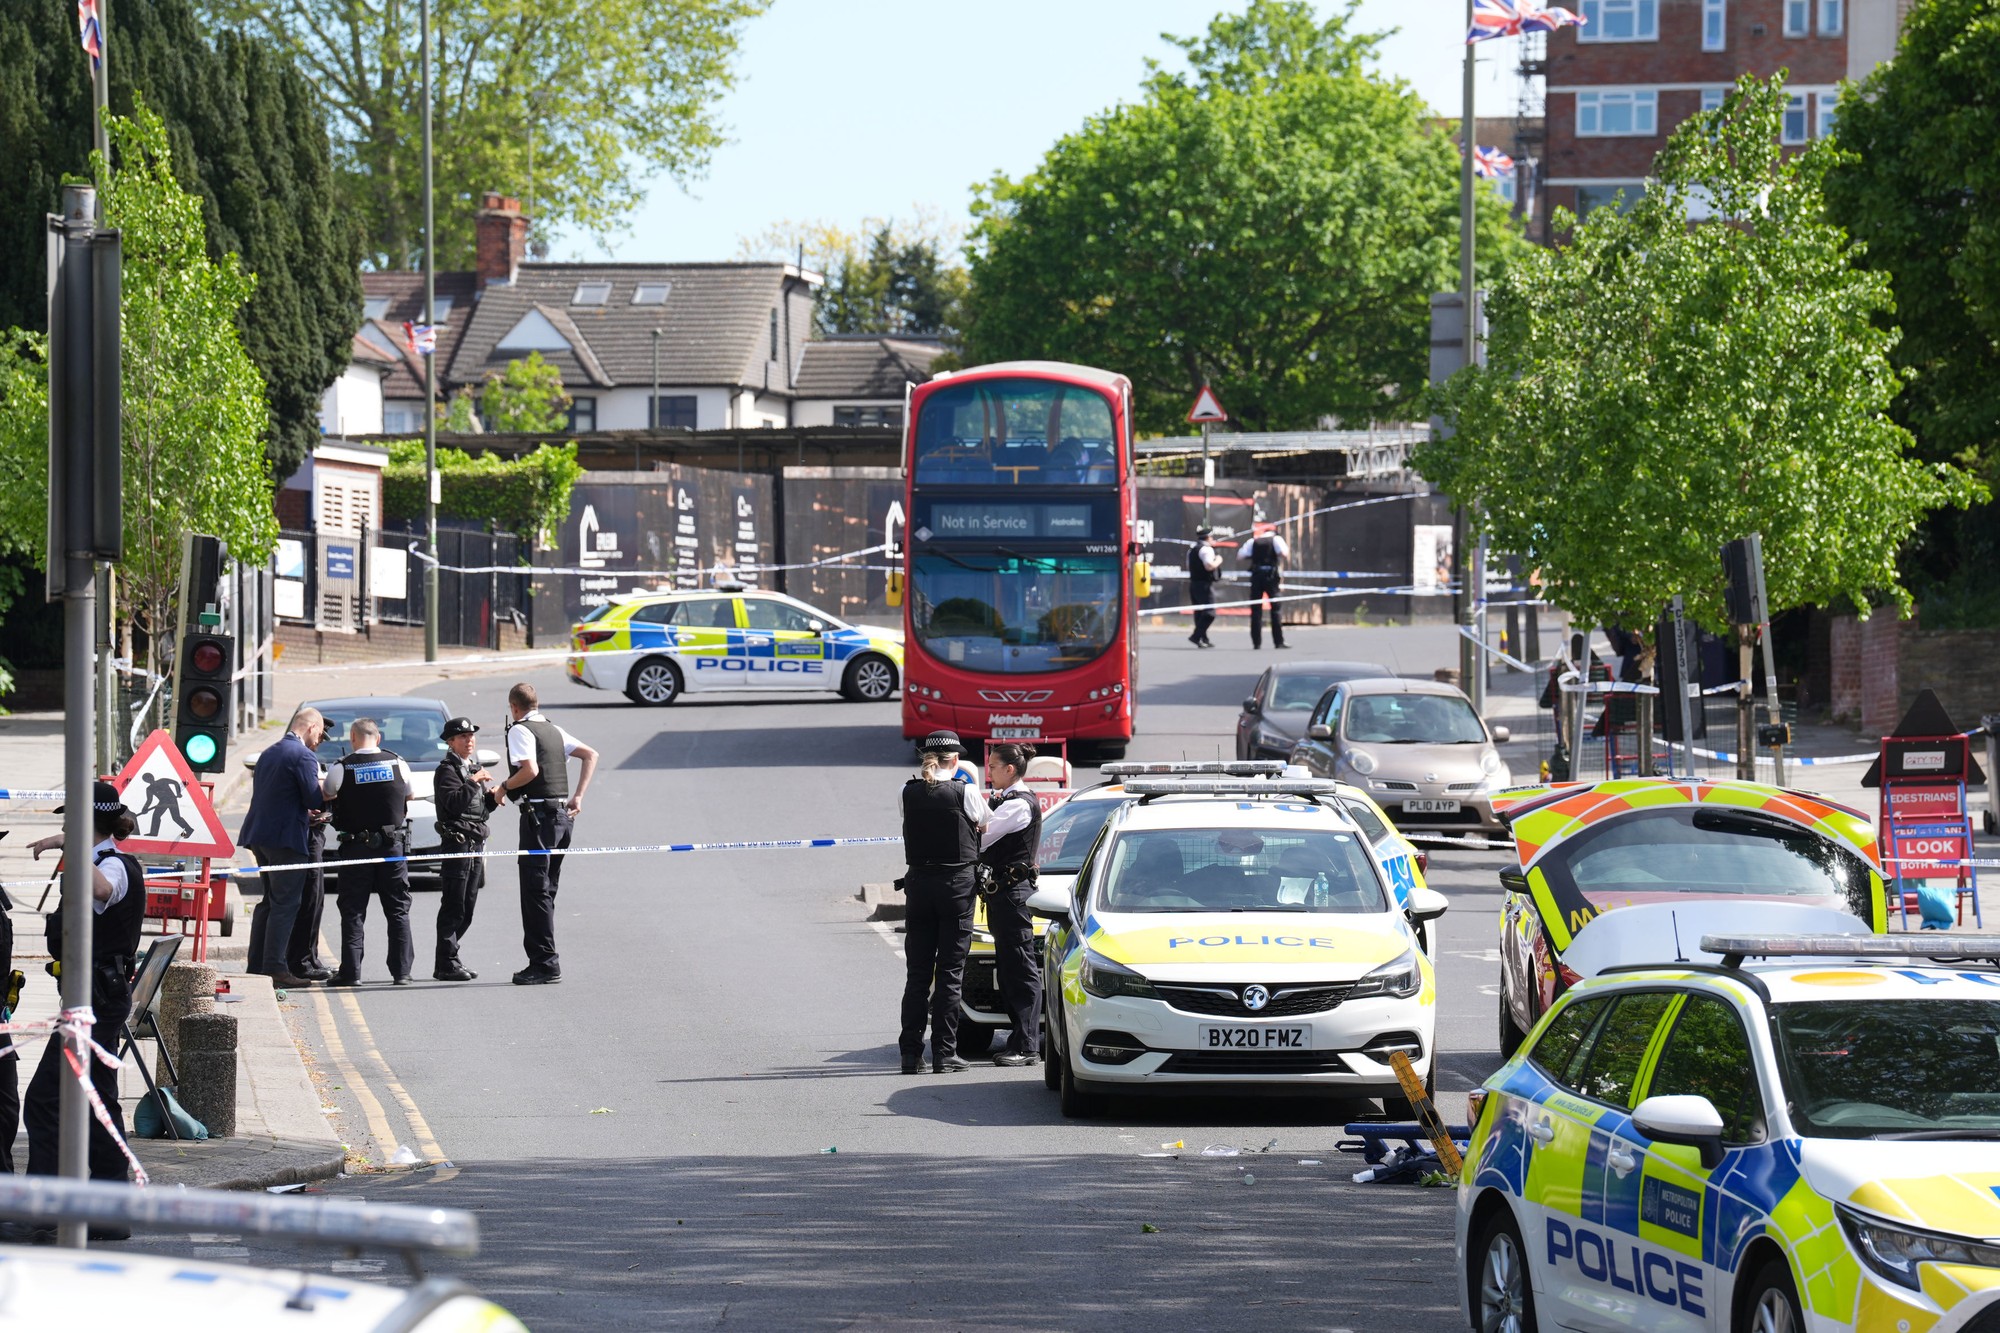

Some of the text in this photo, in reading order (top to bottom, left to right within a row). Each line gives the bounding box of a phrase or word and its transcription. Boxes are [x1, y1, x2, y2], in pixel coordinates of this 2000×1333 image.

[941, 515, 1028, 529] Not in Service
[1086, 545, 1118, 553] VW1269
[696, 658, 823, 673] POLICE
[988, 713, 1044, 725] Metroline
[1020, 729, 1036, 737] AFX
[356, 770, 392, 782] POLICE
[16, 790, 37, 799] POLICE
[40, 791, 53, 800] LINE
[1409, 801, 1455, 811] PL10 AYP
[1906, 841, 1954, 854] LOOK
[1900, 861, 1928, 870] BOTH
[1168, 936, 1335, 949] POLICE
[1208, 1029, 1303, 1047] BX20 FMZ
[1661, 1189, 1698, 1211] METROPOLITAN
[1665, 1210, 1692, 1228] POLICE
[1546, 1216, 1706, 1319] POLICE
